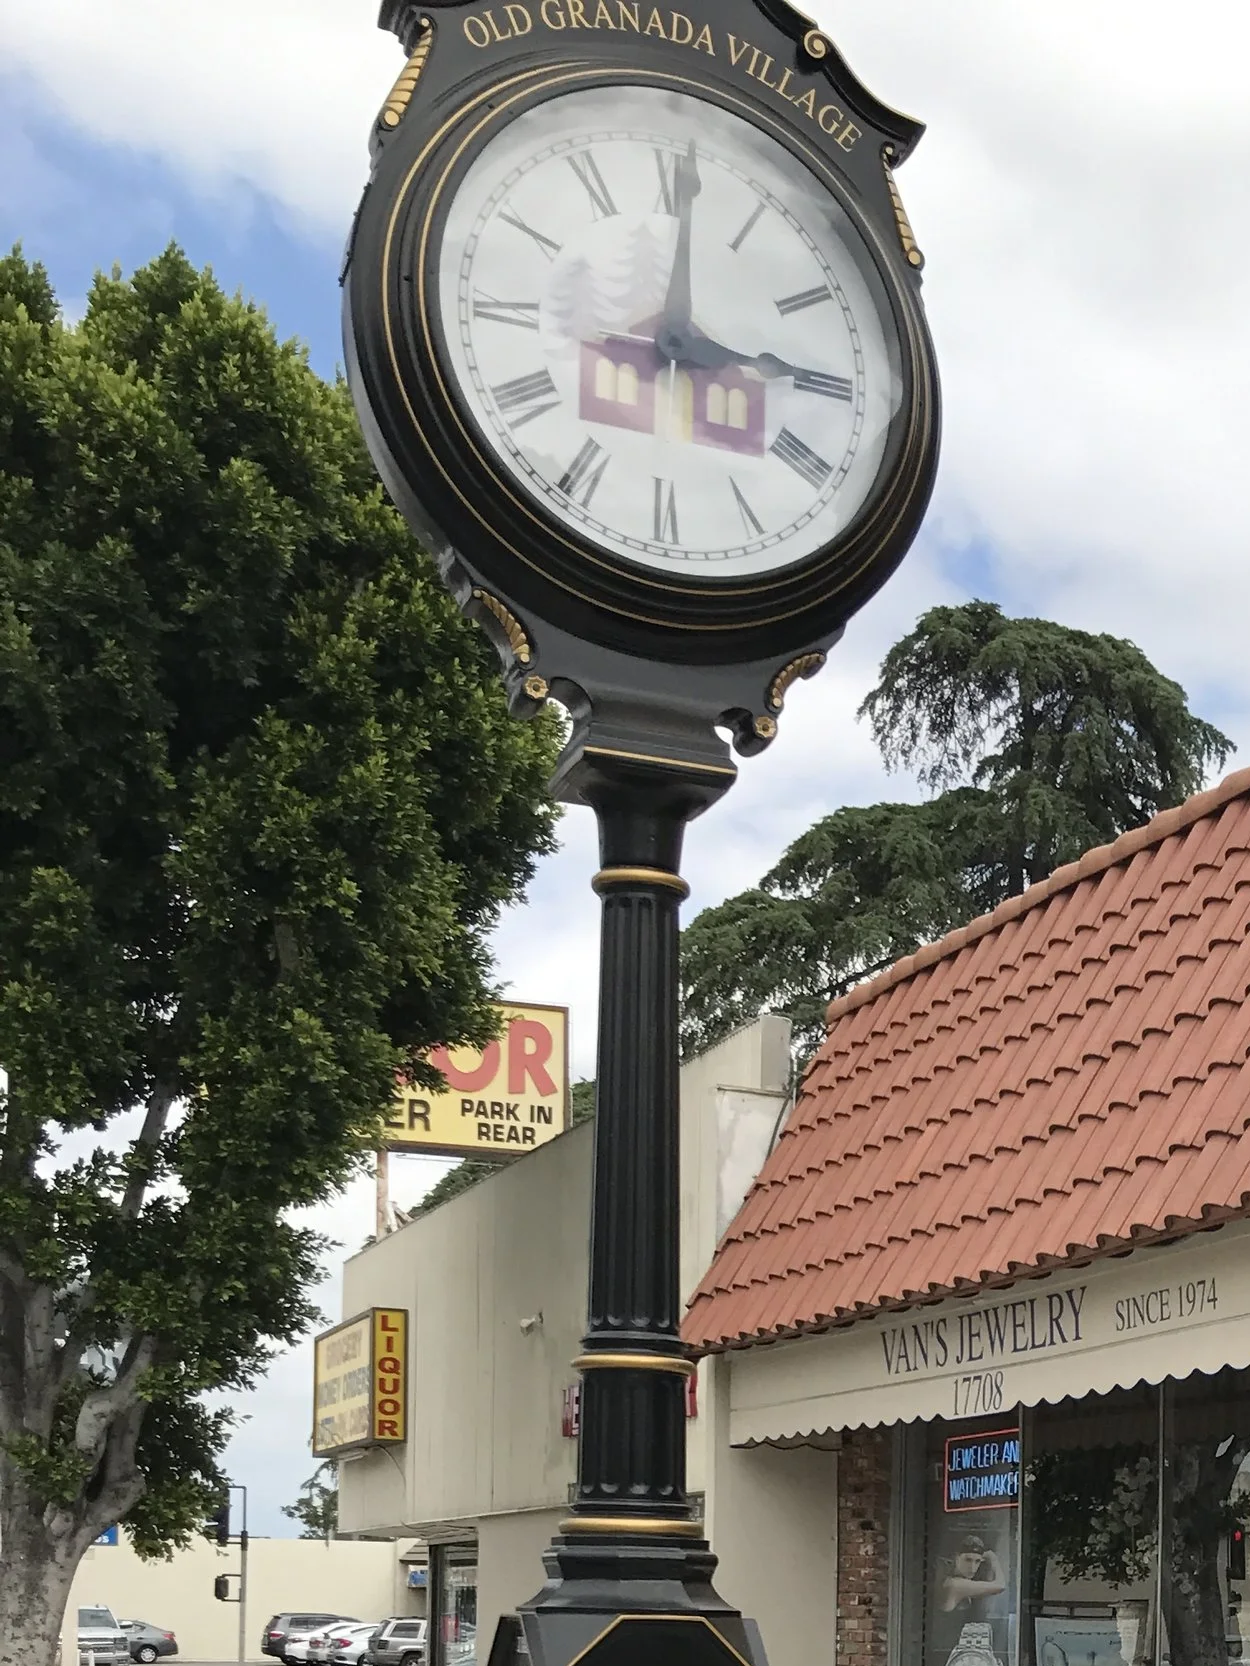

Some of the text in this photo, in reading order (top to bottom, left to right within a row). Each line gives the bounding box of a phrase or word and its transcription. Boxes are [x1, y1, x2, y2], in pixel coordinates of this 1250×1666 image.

[463, 0, 863, 153] OLD GRANADA VILLAGE
[461, 1099, 520, 1122] PARK
[530, 1105, 553, 1125] IN
[478, 1122, 536, 1145] REAR
[880, 1277, 1218, 1375] VAN'S JEWELRY SINCE 1974
[378, 1315, 401, 1437] LIQUOR
[953, 1371, 1004, 1416] 17708
[948, 1443, 999, 1471] JEWELER
